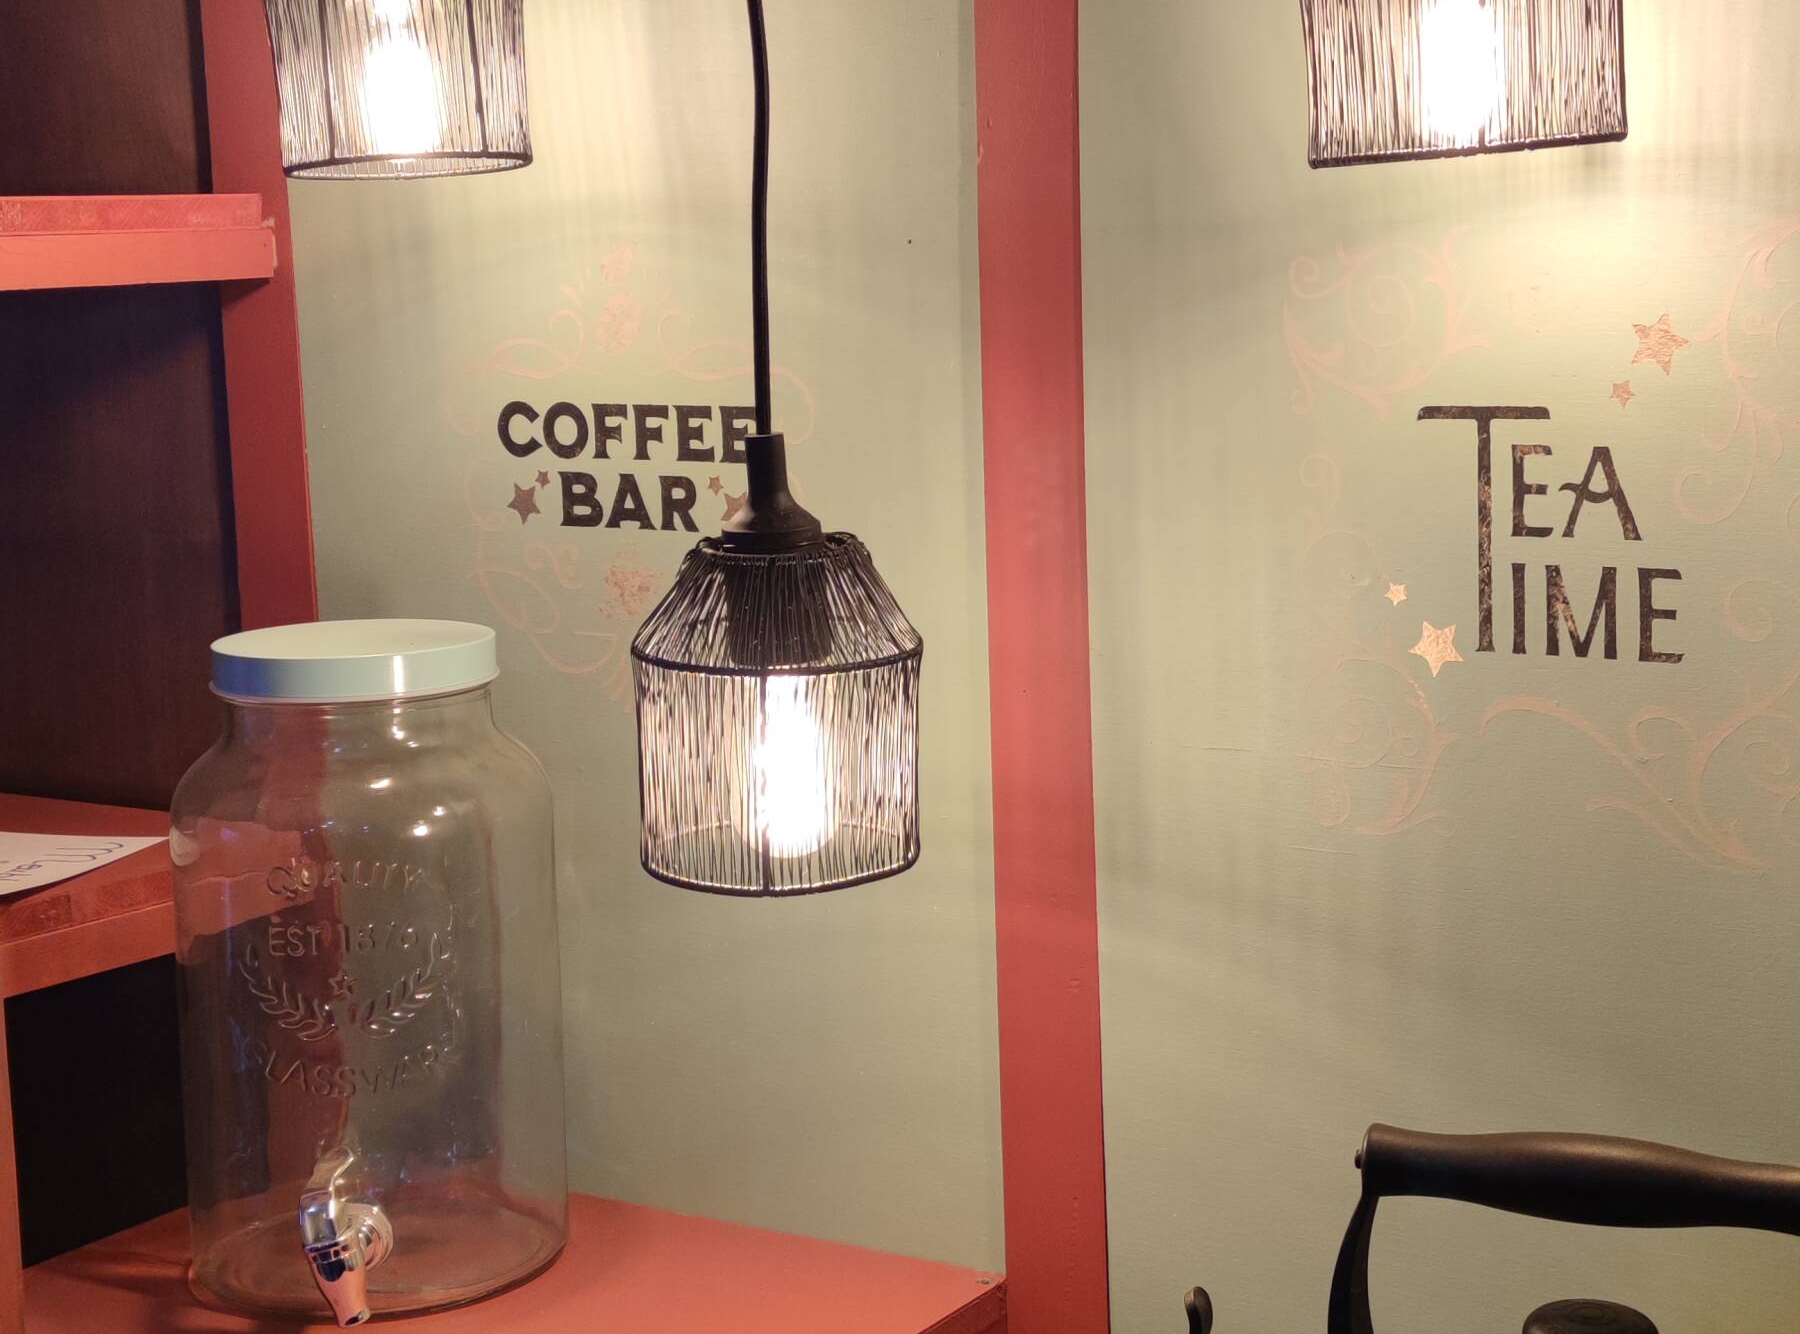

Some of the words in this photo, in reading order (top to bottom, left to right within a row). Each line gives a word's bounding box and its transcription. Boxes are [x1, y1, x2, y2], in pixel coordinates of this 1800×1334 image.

[497, 400, 757, 464] COFFEE
[557, 471, 700, 533] BAR
[1417, 405, 1643, 652] TEA
[266, 857, 426, 899] QUALITY
[268, 923, 323, 957] EST
